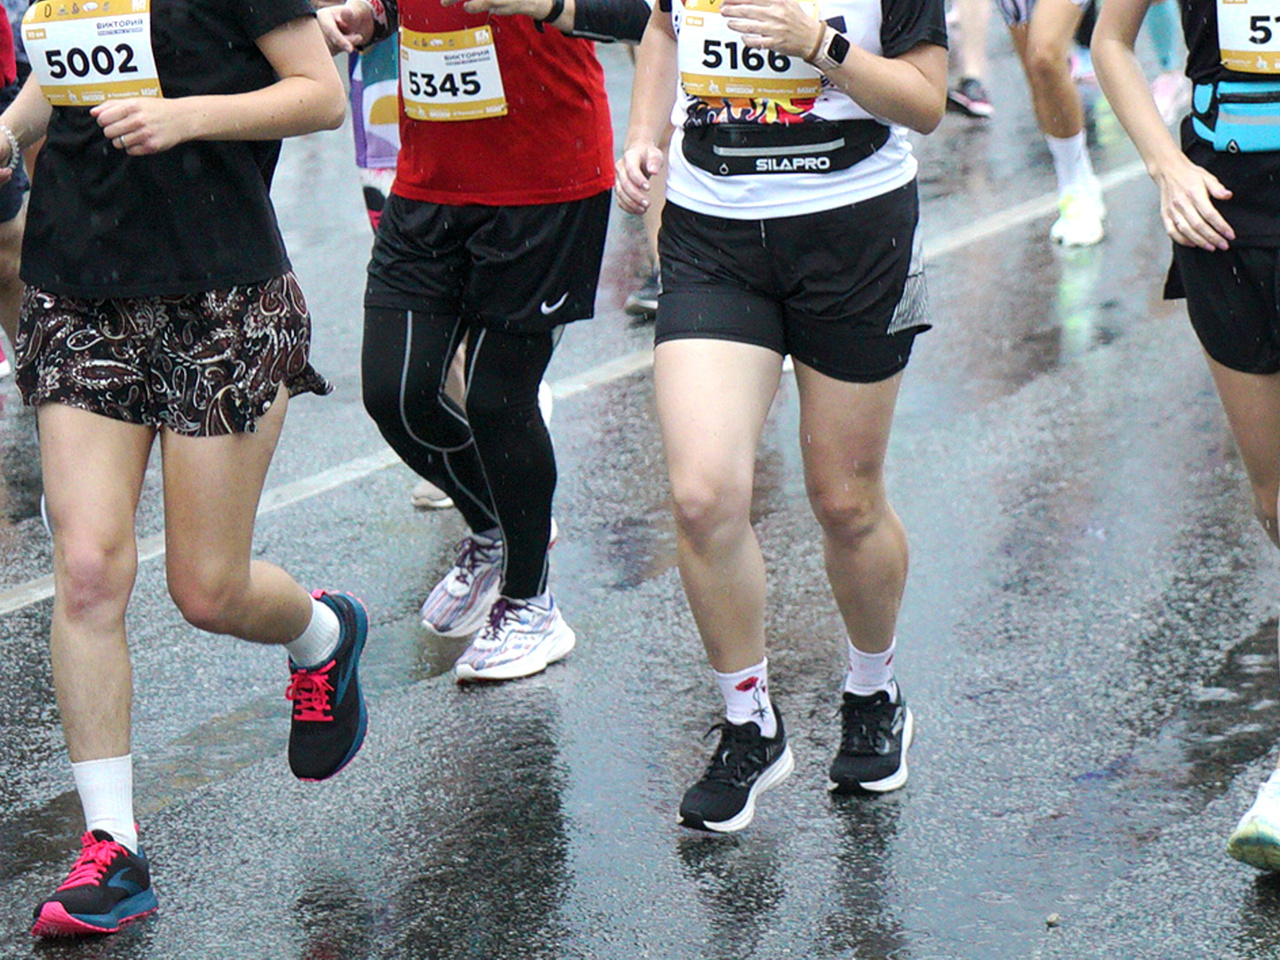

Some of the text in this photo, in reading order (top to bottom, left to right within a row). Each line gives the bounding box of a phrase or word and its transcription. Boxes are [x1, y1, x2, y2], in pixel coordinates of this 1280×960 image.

[45, 43, 139, 79] 5002
[702, 39, 791, 73] 5166
[409, 70, 481, 97] 5345
[756, 157, 830, 171] SILAPRO
